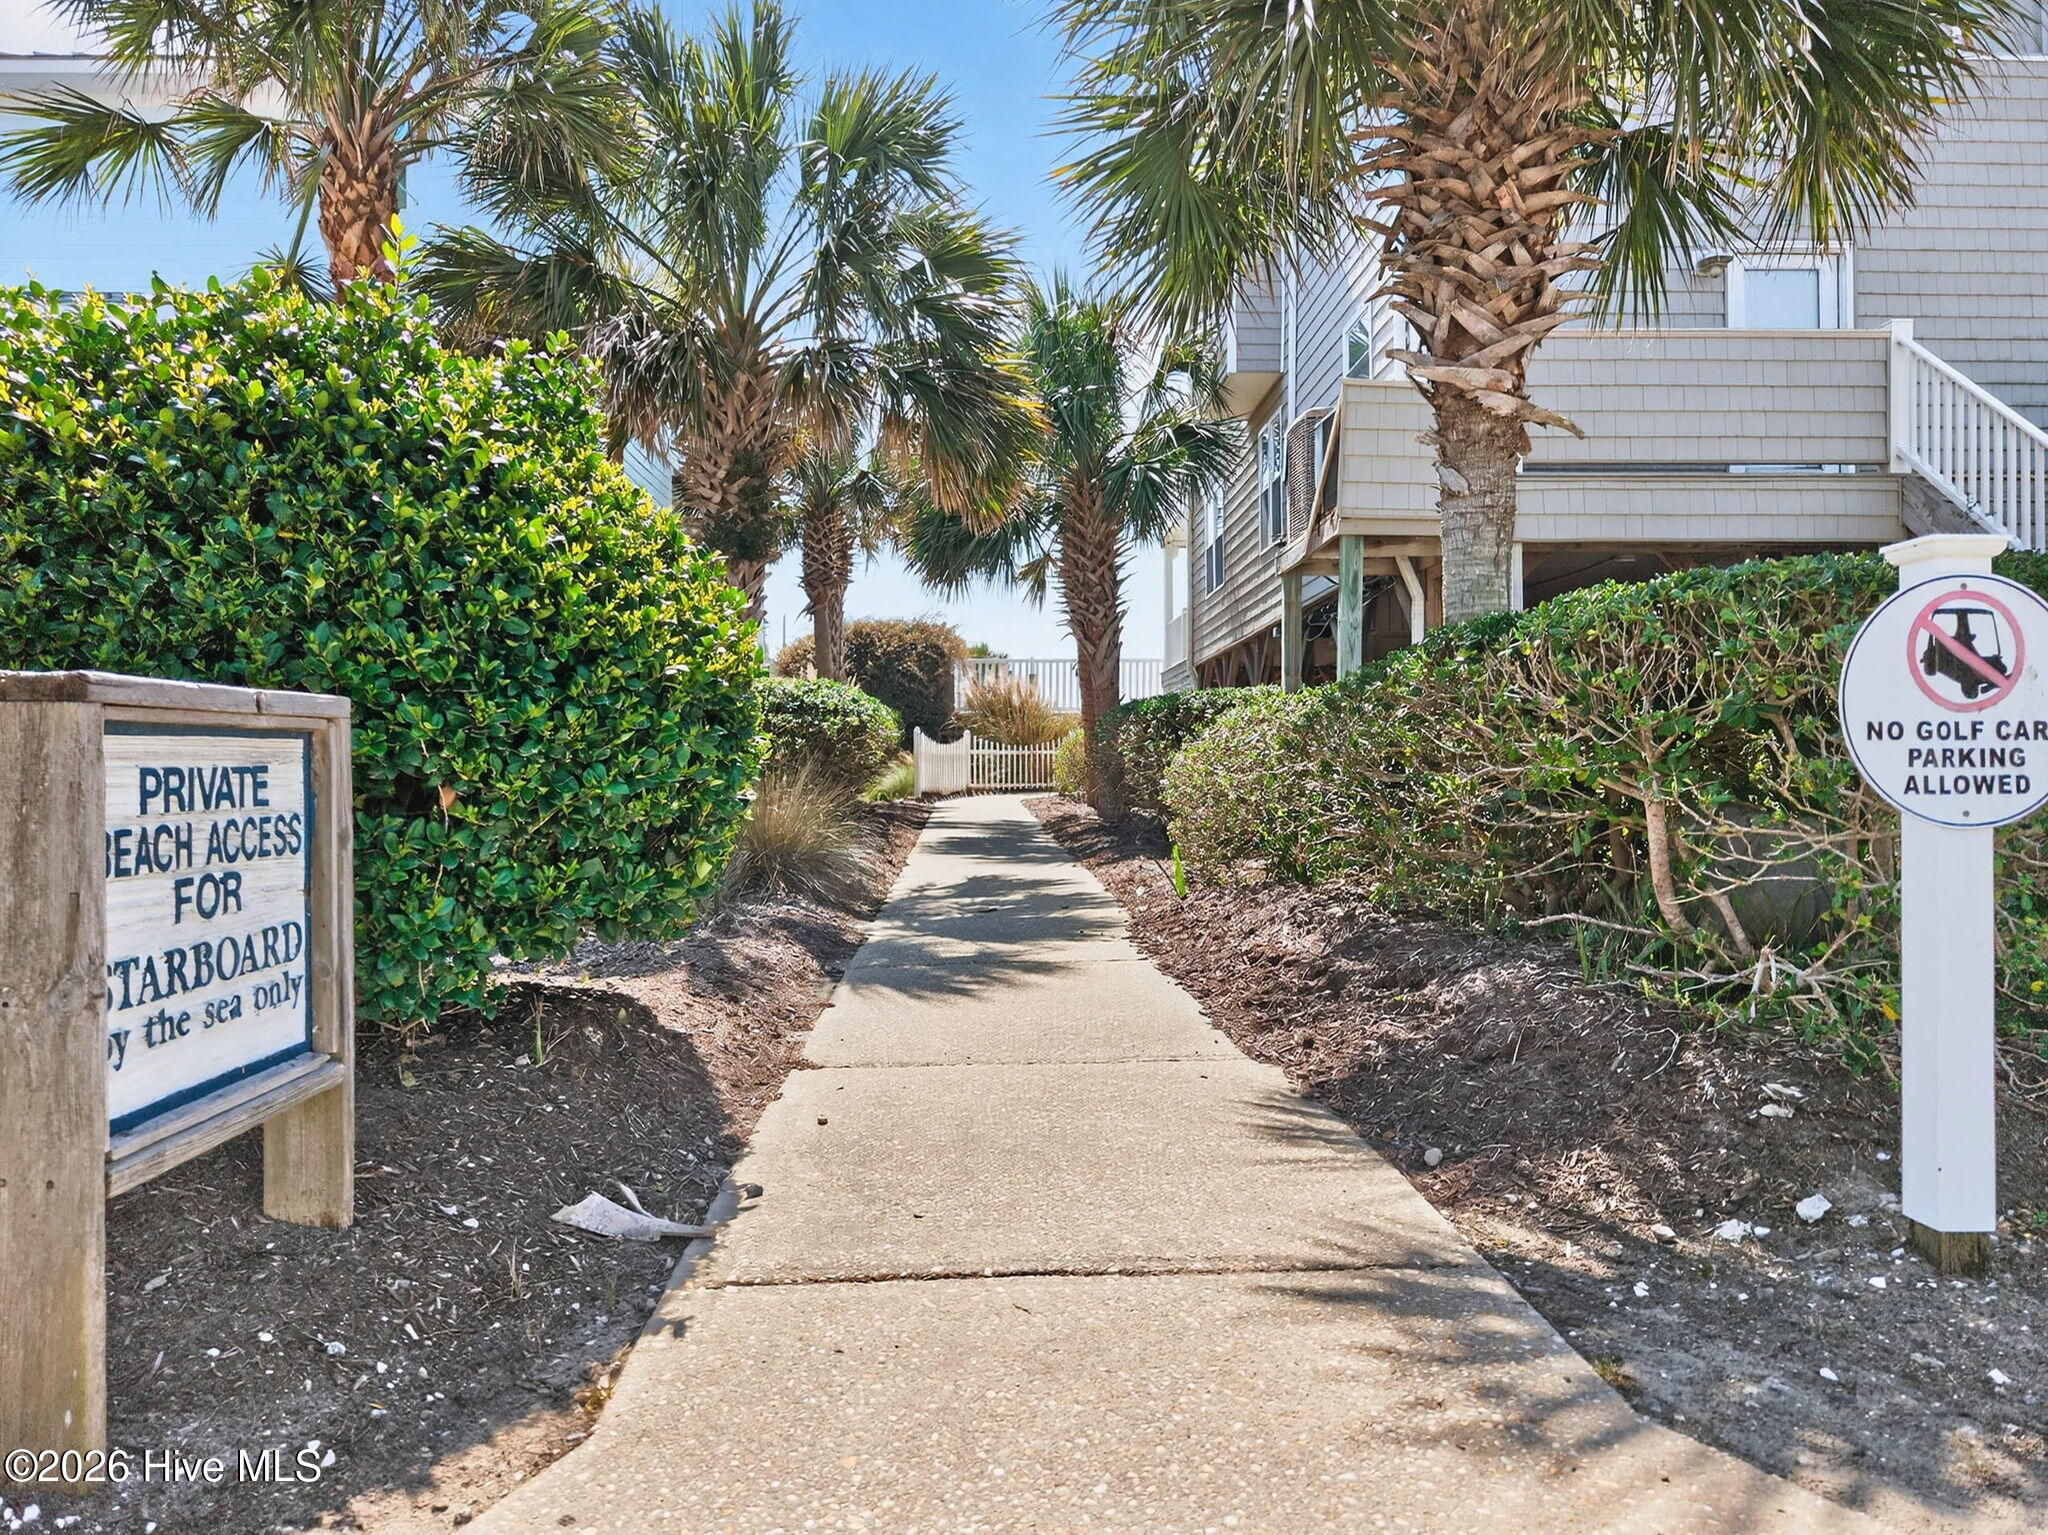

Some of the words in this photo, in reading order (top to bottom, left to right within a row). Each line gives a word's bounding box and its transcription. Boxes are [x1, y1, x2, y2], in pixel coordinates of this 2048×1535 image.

[1866, 720, 1904, 741] NO
[1916, 720, 1985, 741] GOLF
[1907, 747, 2026, 768] PARKING
[139, 765, 270, 816] PRIVATE
[1903, 774, 2031, 795] ALLOWED
[206, 812, 302, 866] ACCESS
[173, 871, 242, 925] FOR
[144, 1007, 191, 1049] the
[203, 994, 242, 1029] sea
[254, 970, 303, 1010] only
